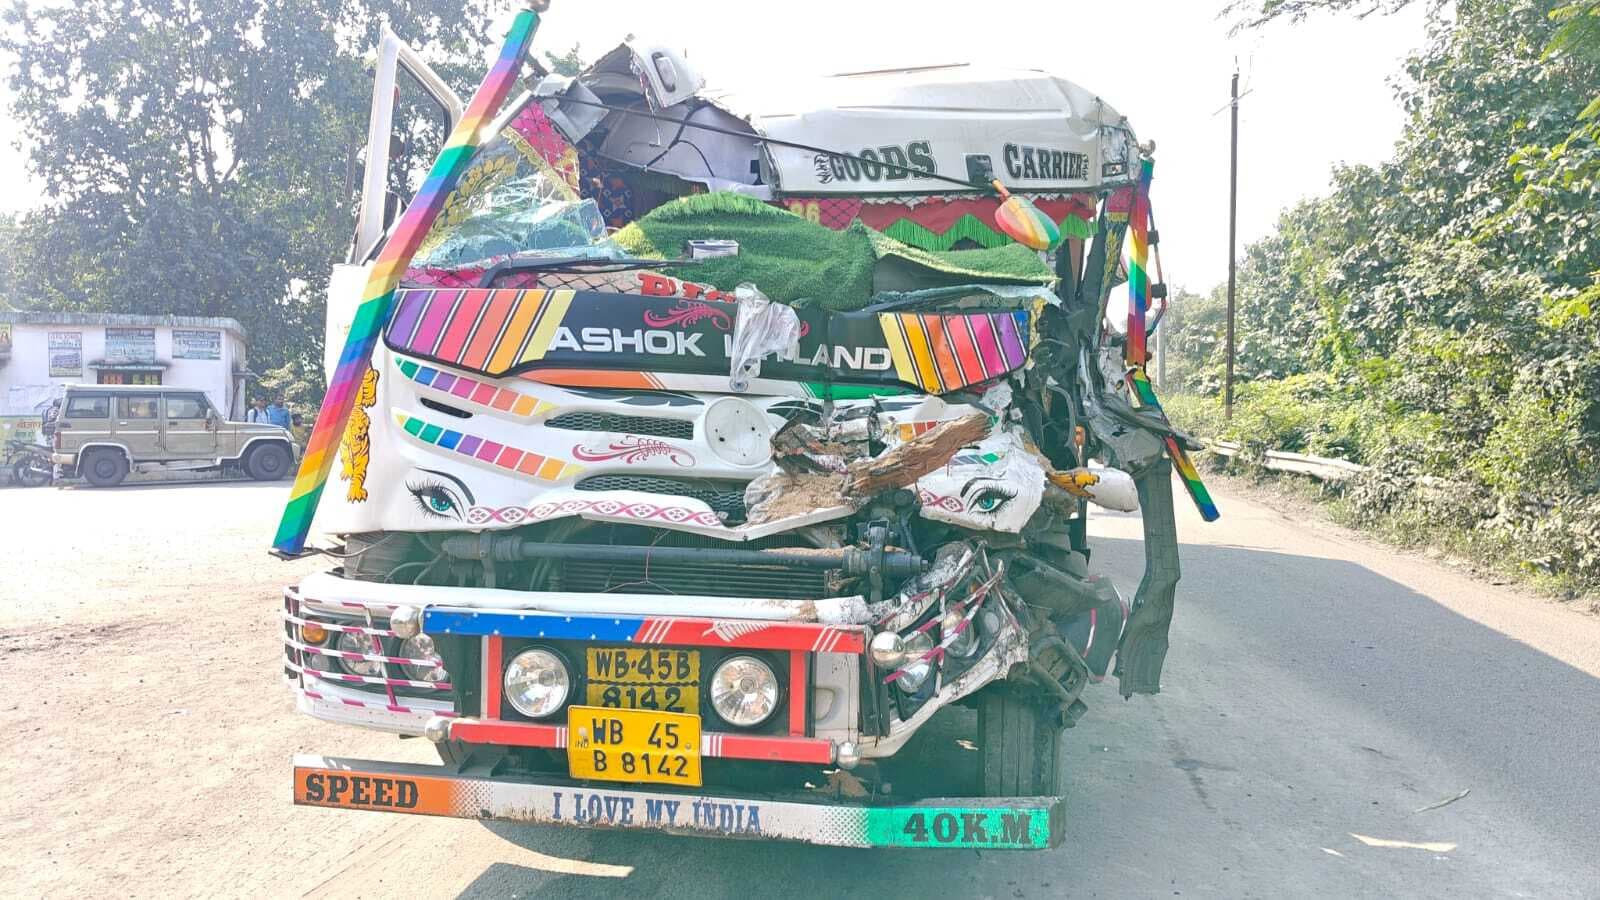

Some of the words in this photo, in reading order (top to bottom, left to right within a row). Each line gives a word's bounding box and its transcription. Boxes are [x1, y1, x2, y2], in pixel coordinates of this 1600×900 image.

[828, 142, 935, 181] GOODS
[1004, 144, 1082, 179] CARRIER
[547, 326, 706, 357] ASHOK
[724, 333, 892, 371] LLAND
[602, 688, 685, 713] 8142
[592, 718, 623, 745] WB
[648, 722, 679, 749] 45
[593, 750, 607, 772] B
[621, 752, 688, 777] 8142
[306, 774, 418, 808] SPEED
[553, 792, 563, 819] I
[574, 793, 634, 824] LOVE
[646, 799, 681, 825] MY
[692, 800, 761, 833] INDIA
